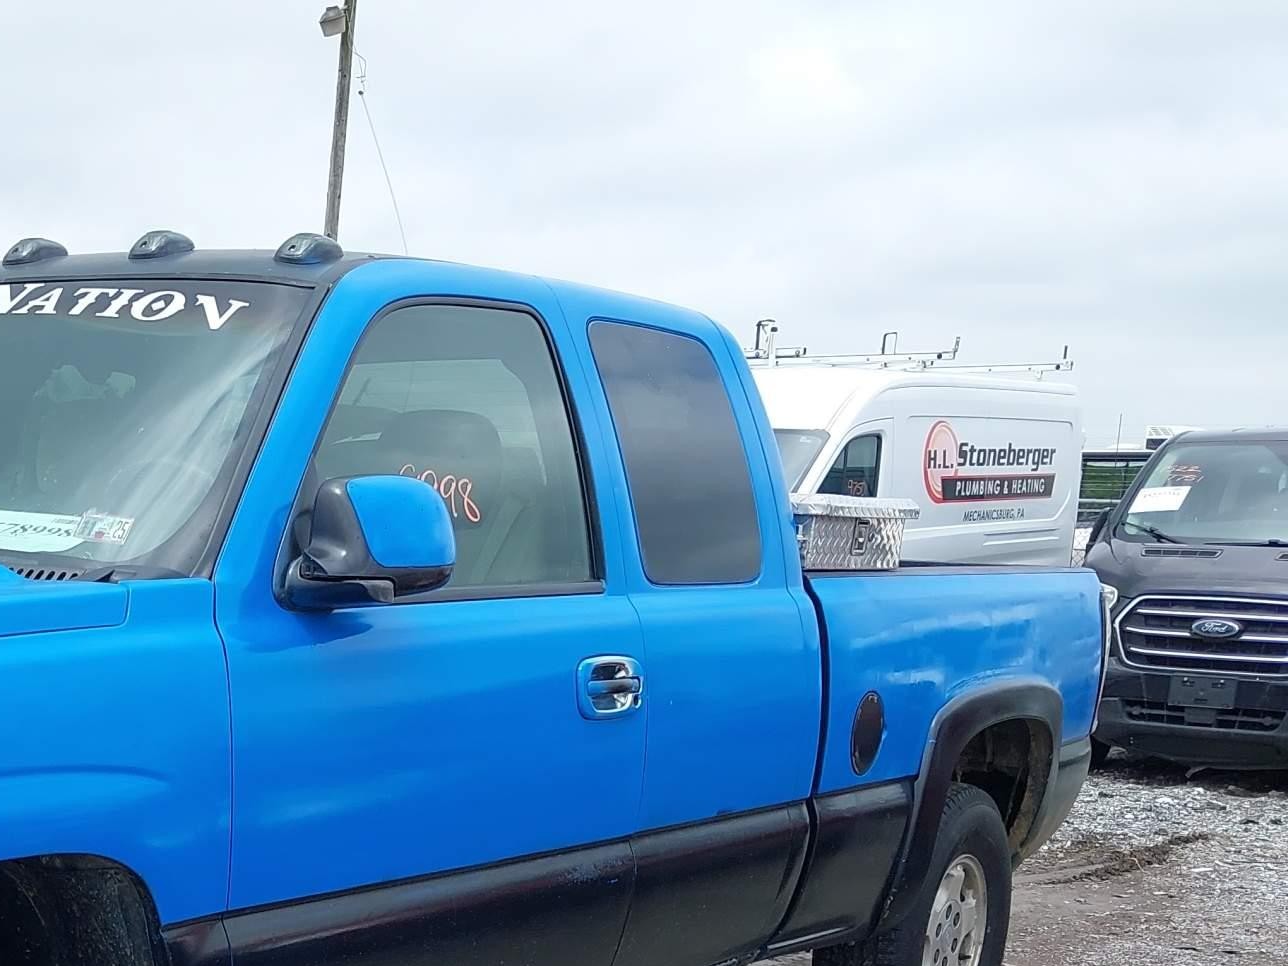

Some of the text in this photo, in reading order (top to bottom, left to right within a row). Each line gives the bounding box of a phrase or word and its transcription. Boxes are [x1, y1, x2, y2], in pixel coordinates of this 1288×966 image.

[927, 442, 1056, 472] H.L. Stoneberger
[400, 464, 480, 522] 98
[955, 479, 1045, 496] PLUMBING & HEATING
[1016, 508, 1025, 519] PA
[1201, 622, 1228, 633] Ford
